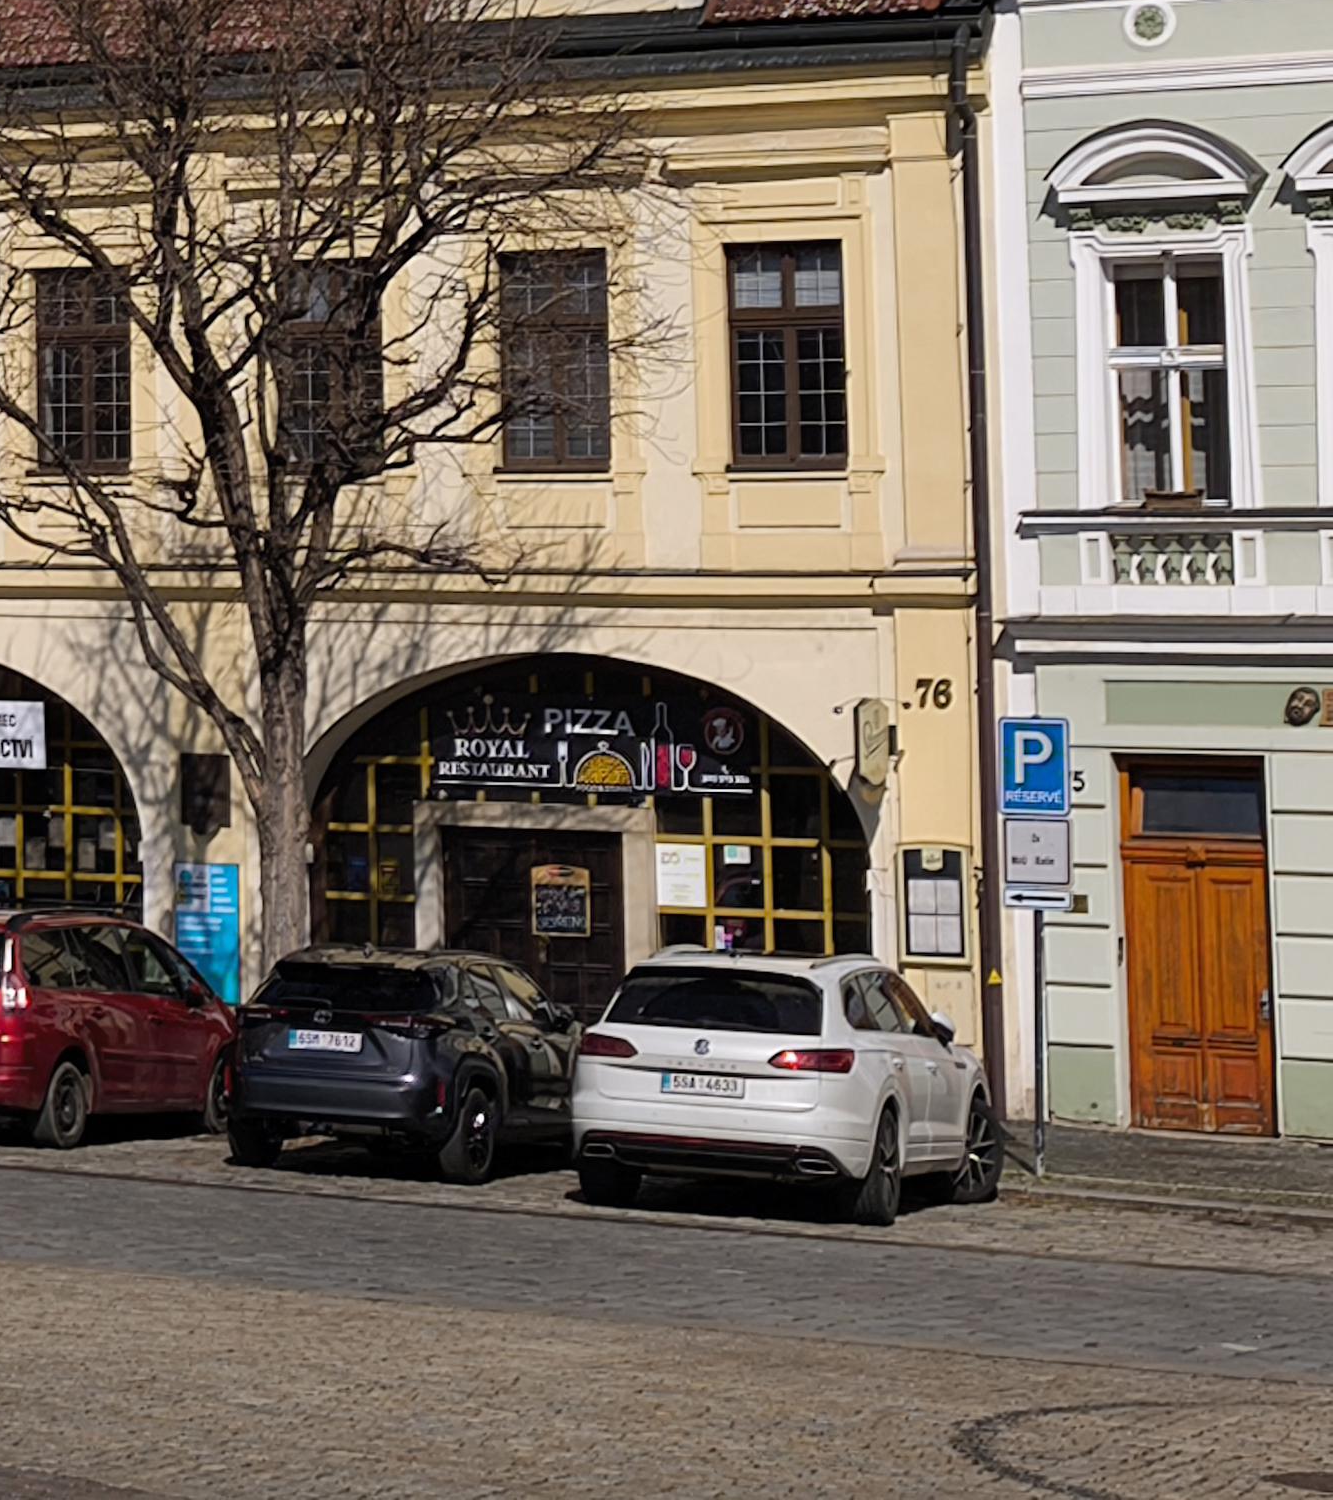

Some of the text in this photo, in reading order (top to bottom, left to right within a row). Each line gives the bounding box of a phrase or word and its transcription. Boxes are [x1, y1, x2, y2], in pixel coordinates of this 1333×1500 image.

[915, 678, 953, 710] 76
[543, 707, 636, 737] PIZZA
[454, 737, 531, 760] ROYAL
[1013, 729, 1054, 785] P
[437, 757, 551, 780] RESTAURANT
[1004, 786, 1063, 805] RÉSERVÉ
